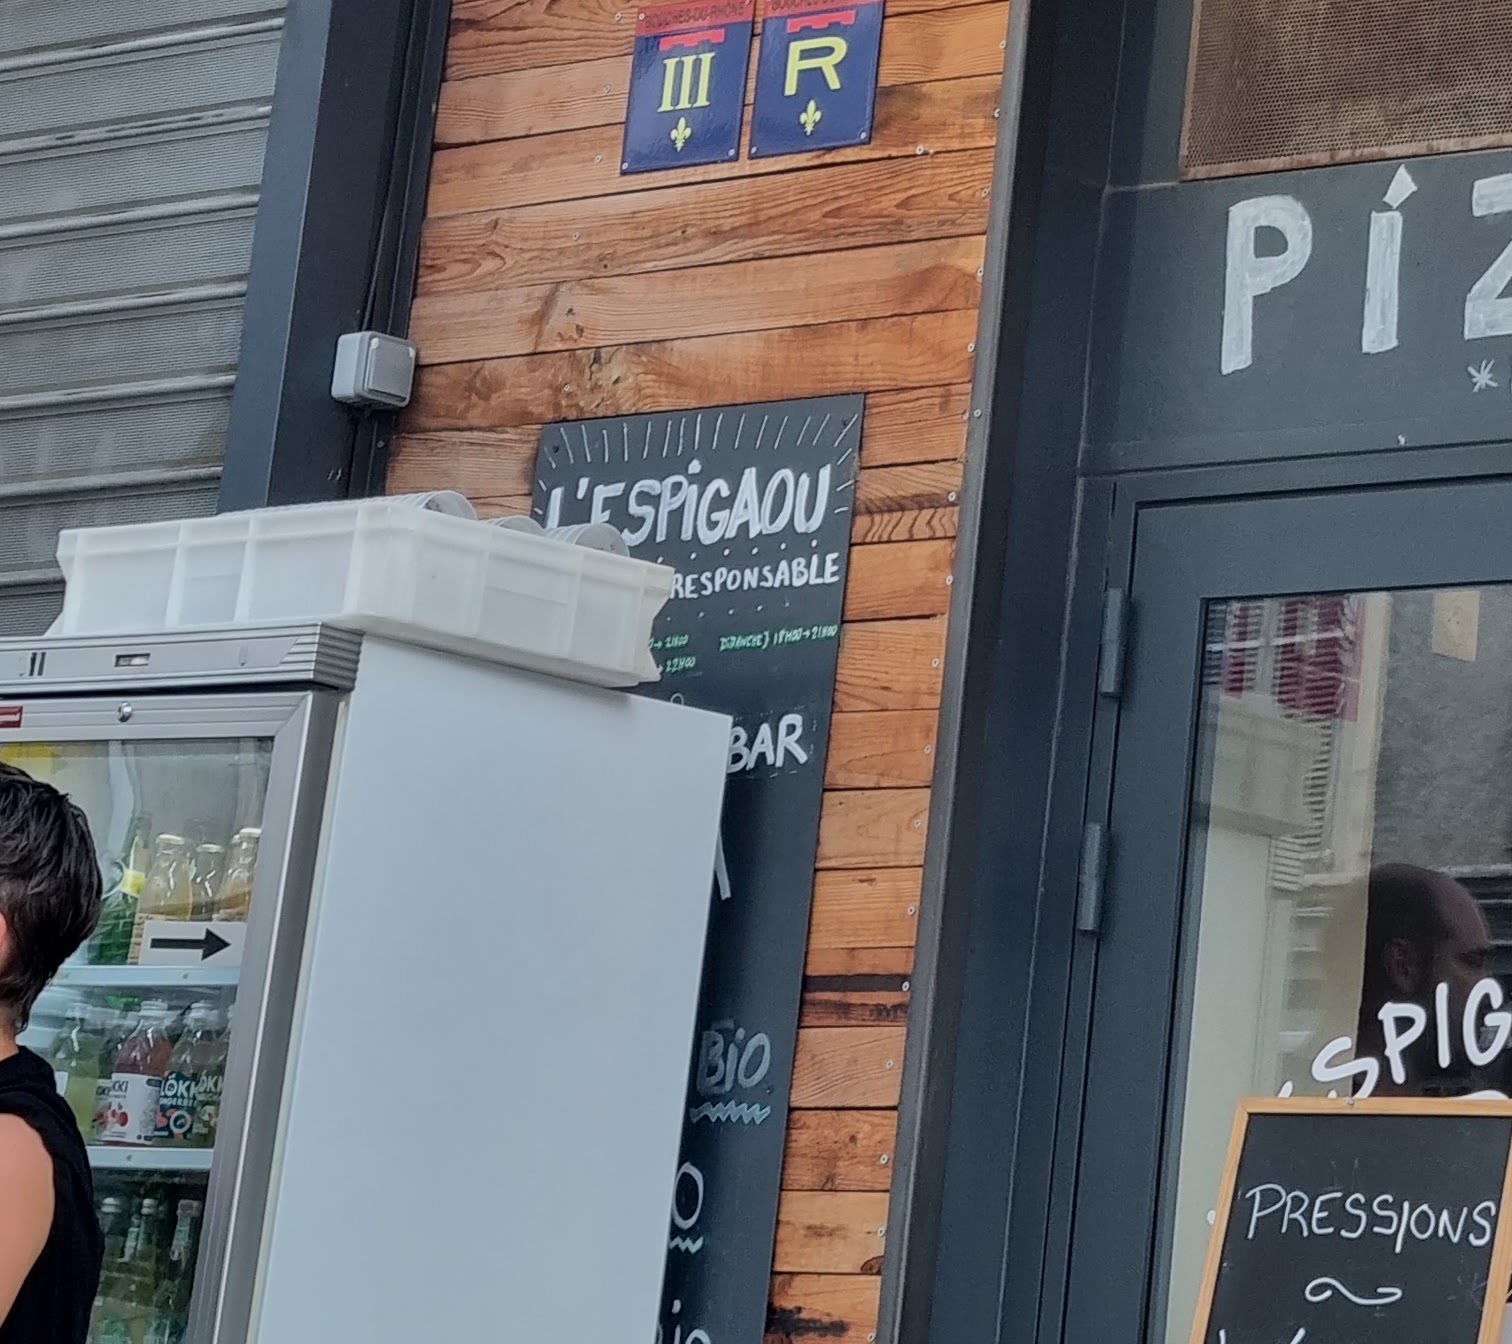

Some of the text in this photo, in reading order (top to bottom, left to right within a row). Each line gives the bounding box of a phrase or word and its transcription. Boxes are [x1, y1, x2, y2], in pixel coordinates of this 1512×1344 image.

[784, 36, 848, 96] R
[669, 552, 840, 599] RESPONSABLE
[1245, 1182, 1498, 1254] PRESSIONS
